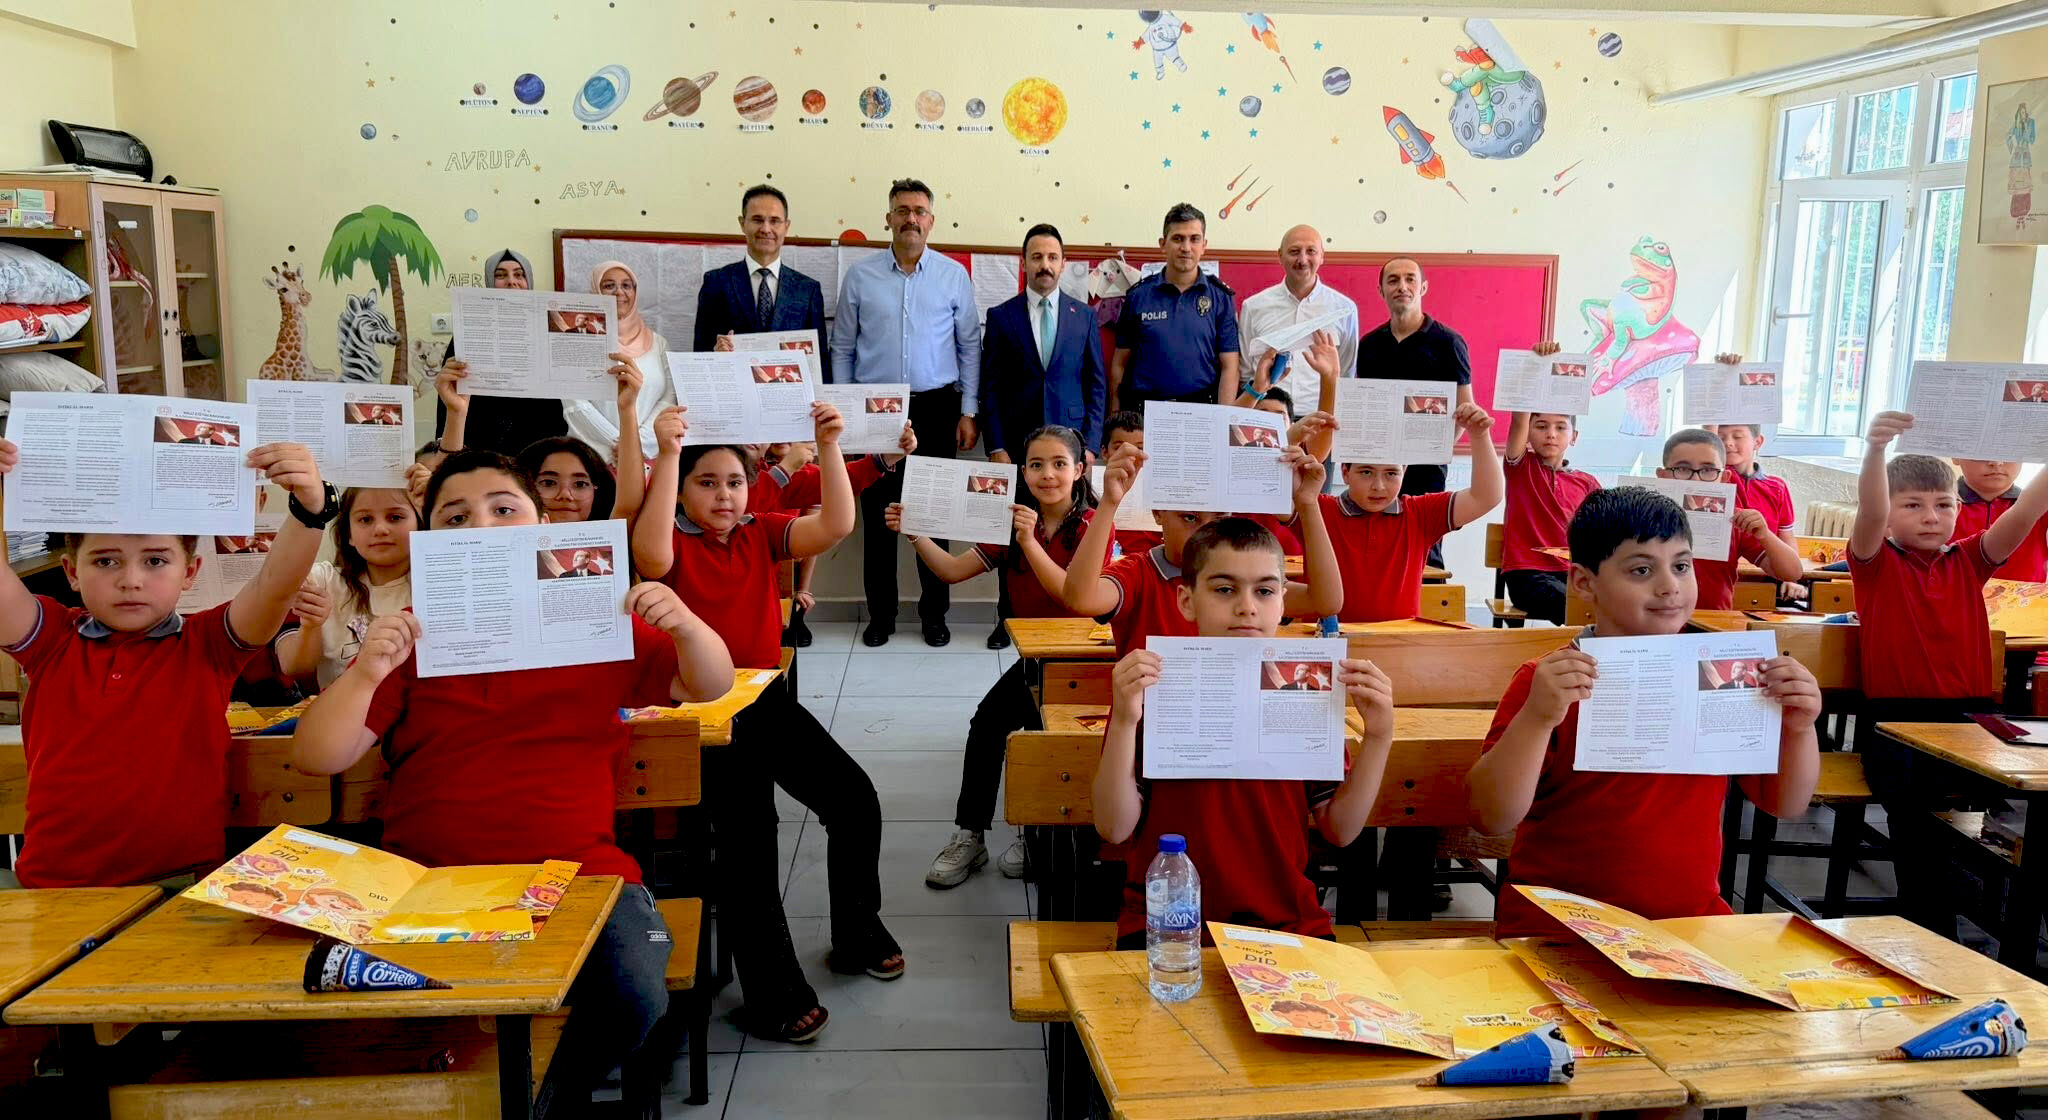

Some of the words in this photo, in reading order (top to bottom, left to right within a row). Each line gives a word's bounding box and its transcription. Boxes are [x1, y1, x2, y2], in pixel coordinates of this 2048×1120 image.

[444, 149, 531, 171] AVRUPA
[560, 180, 619, 199] ASYA
[270, 849, 299, 861] DID
[1164, 911, 1196, 924] KAYIN
[1567, 910, 1600, 921] DID
[1245, 954, 1277, 966] DID
[348, 952, 361, 986] OREO
[363, 960, 418, 987] Cornetto
